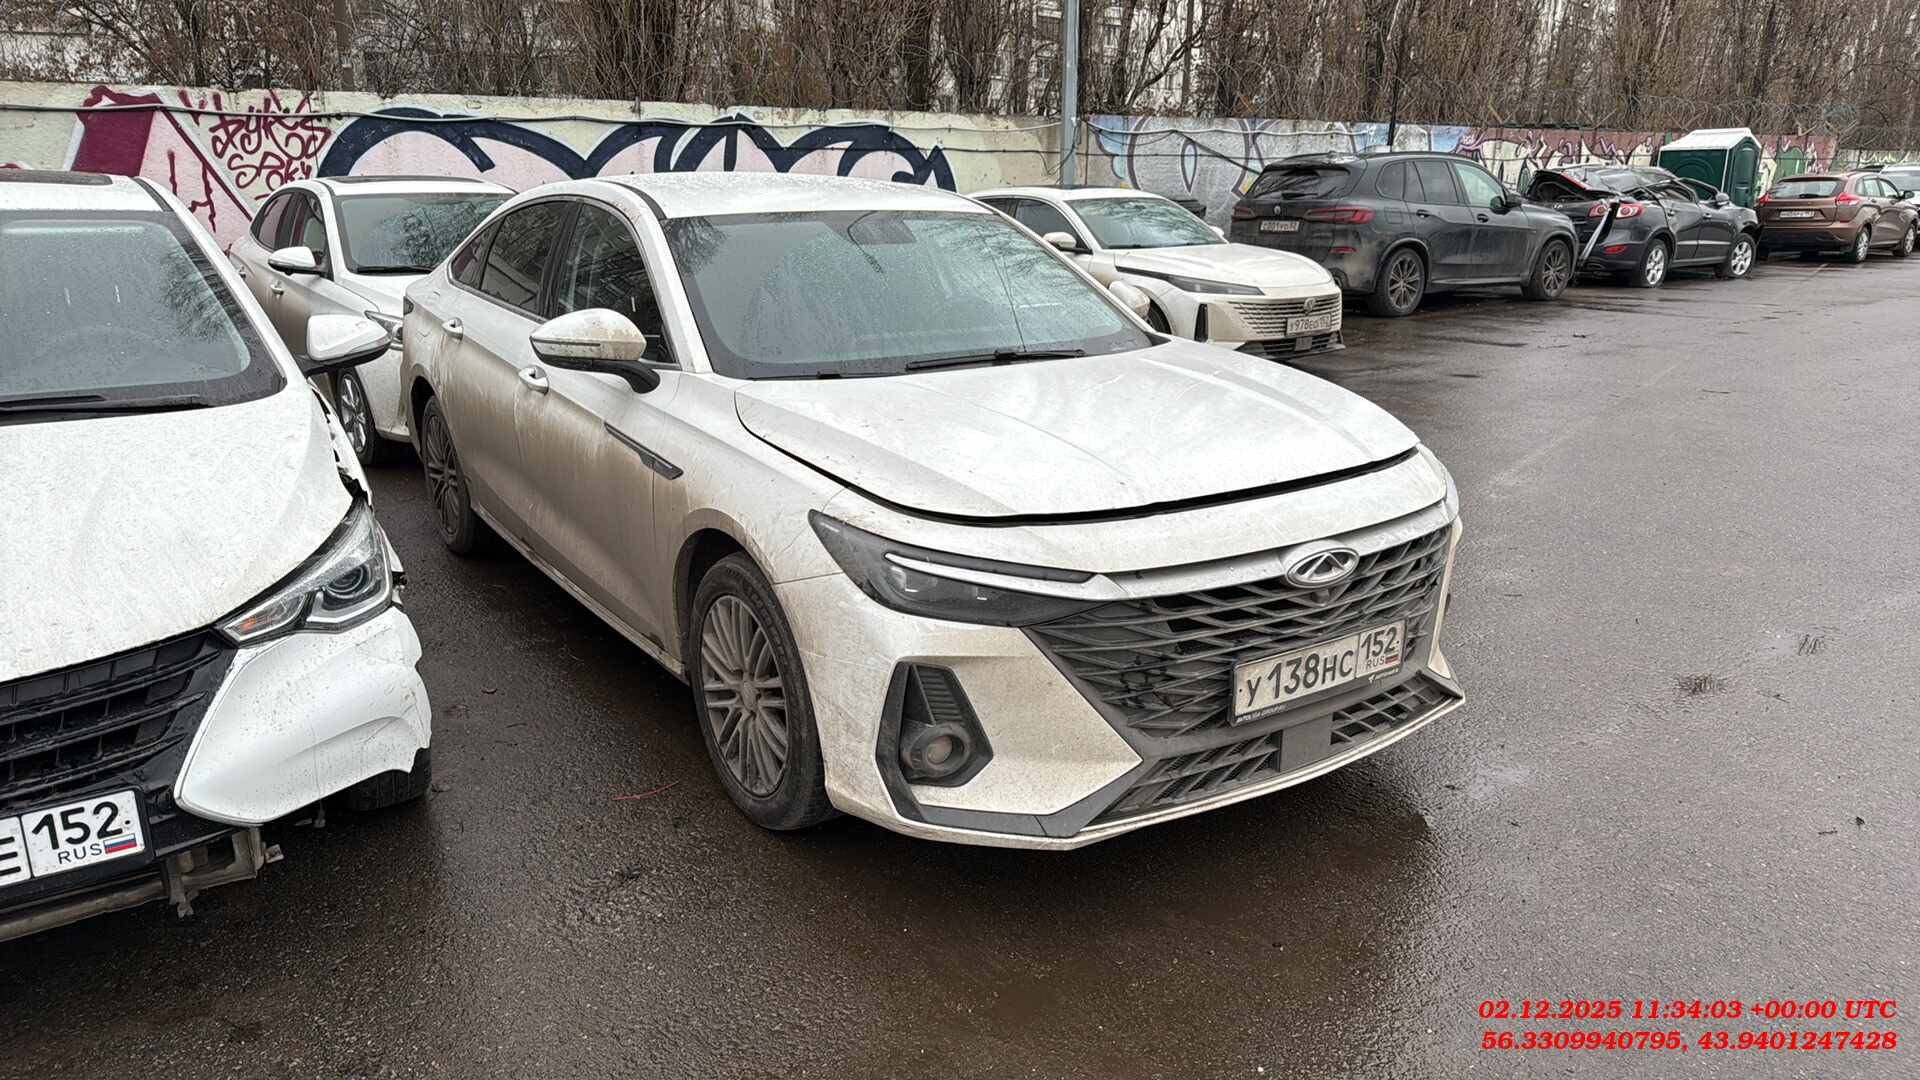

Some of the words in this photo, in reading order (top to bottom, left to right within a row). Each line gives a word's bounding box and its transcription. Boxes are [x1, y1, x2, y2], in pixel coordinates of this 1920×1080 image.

[1247, 650, 1354, 707] У138НС
[1361, 626, 1398, 660] 152
[1366, 655, 1385, 670] RUS
[32, 801, 123, 850] 152
[57, 843, 103, 864] RUS
